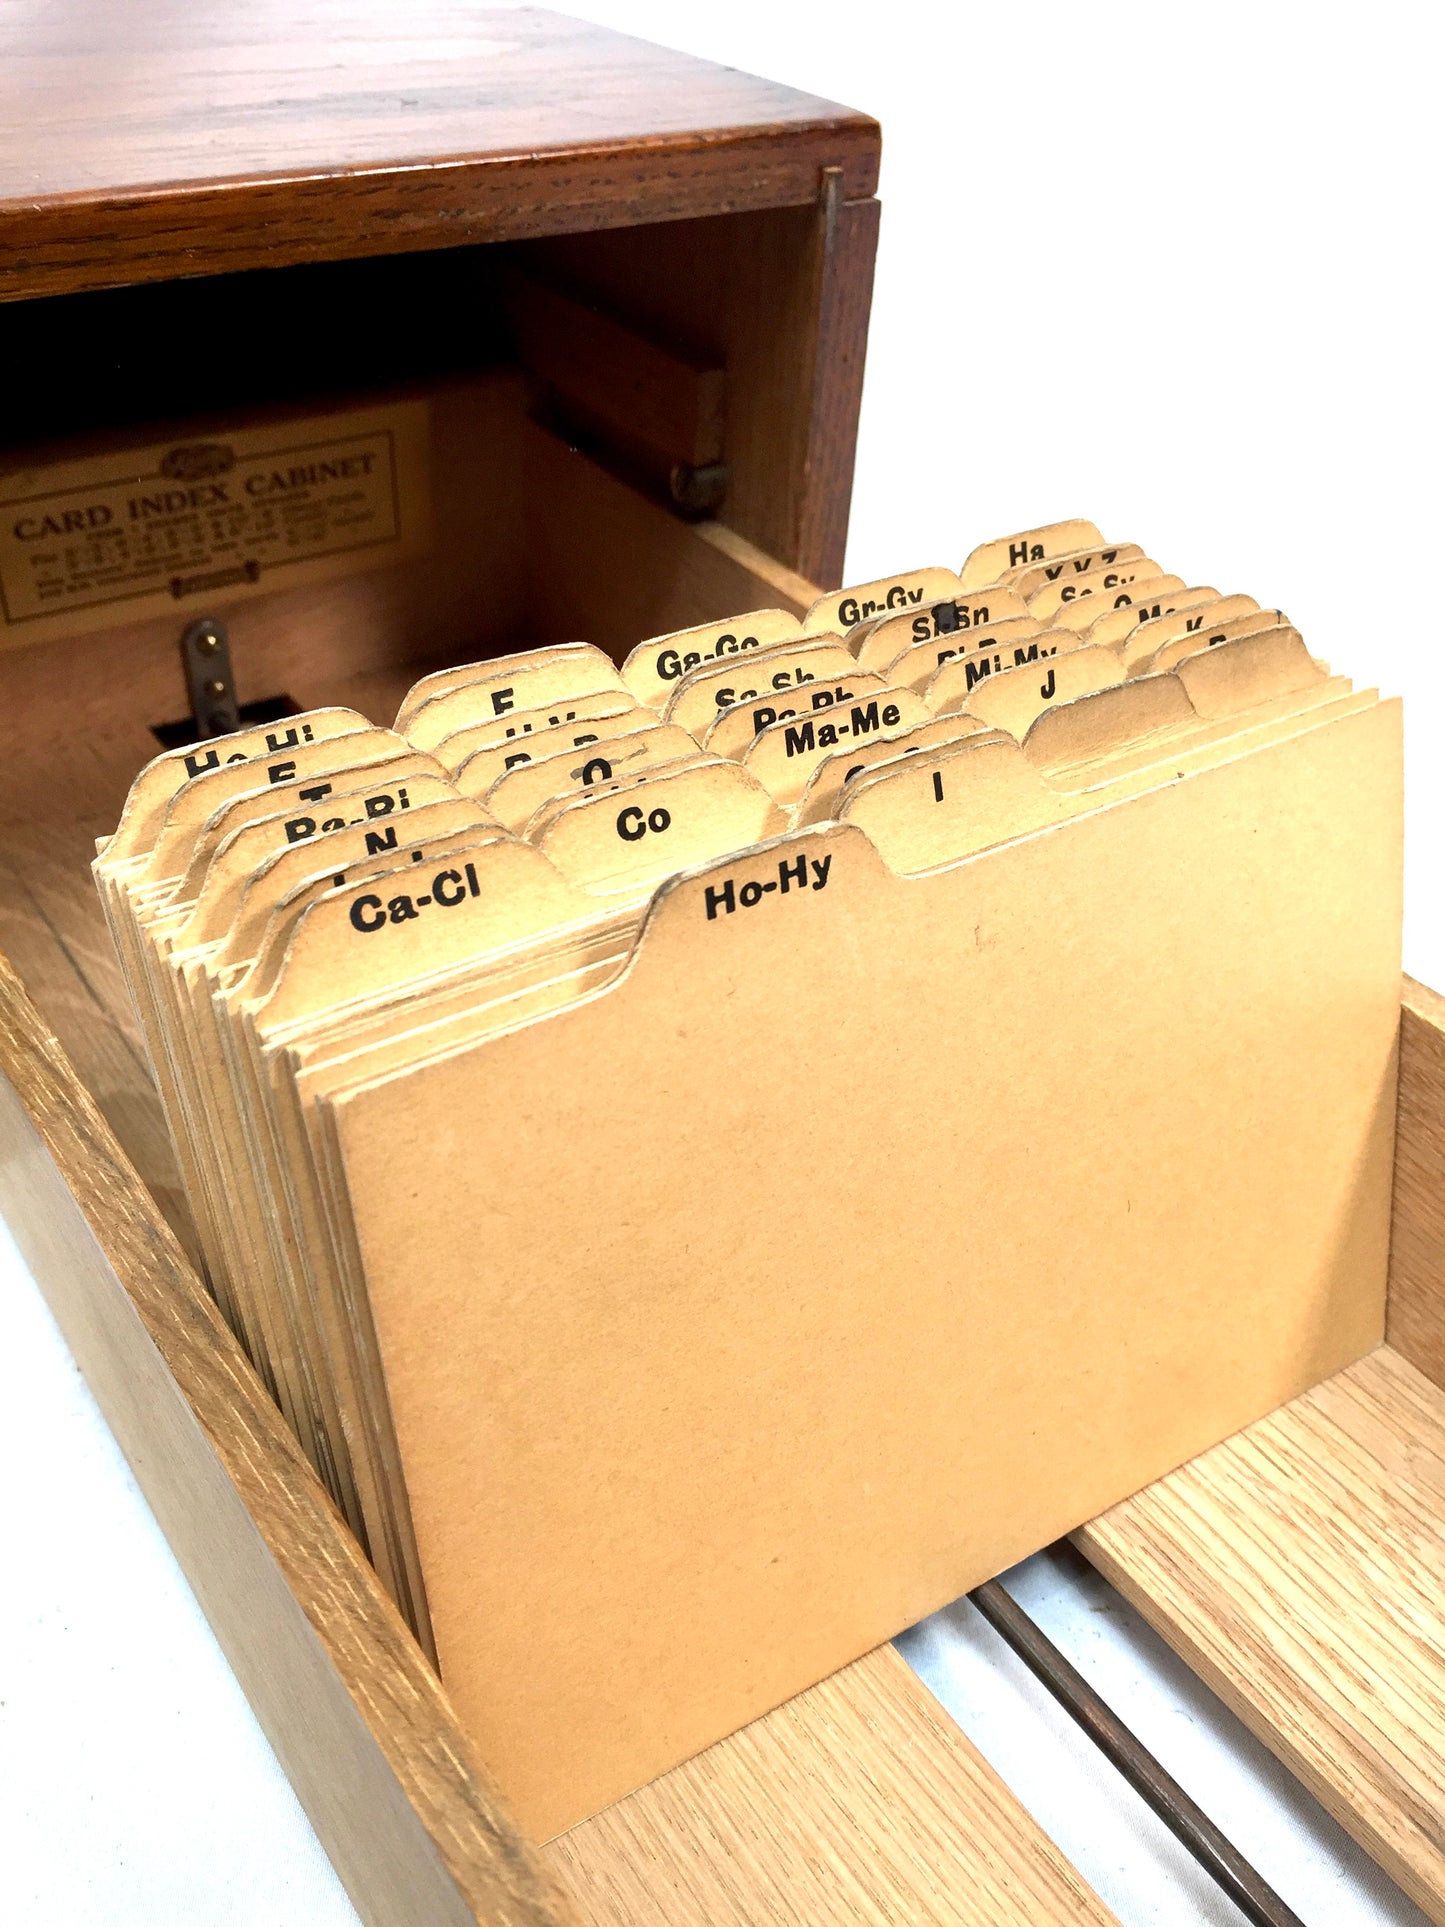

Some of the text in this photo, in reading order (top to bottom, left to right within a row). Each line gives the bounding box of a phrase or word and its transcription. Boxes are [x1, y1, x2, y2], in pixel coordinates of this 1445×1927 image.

[14, 505, 114, 541] CARD
[127, 483, 229, 521] INDEX
[245, 453, 375, 494] CABINET
[1009, 541, 1045, 568] Ha
[1040, 669, 1056, 700] J
[784, 701, 901, 758] Ma-Me
[932, 771, 944, 803] I
[364, 826, 398, 857] N
[616, 806, 672, 842] Co
[349, 862, 482, 933] Ca-Cl
[704, 853, 833, 921] Ho-Hy
